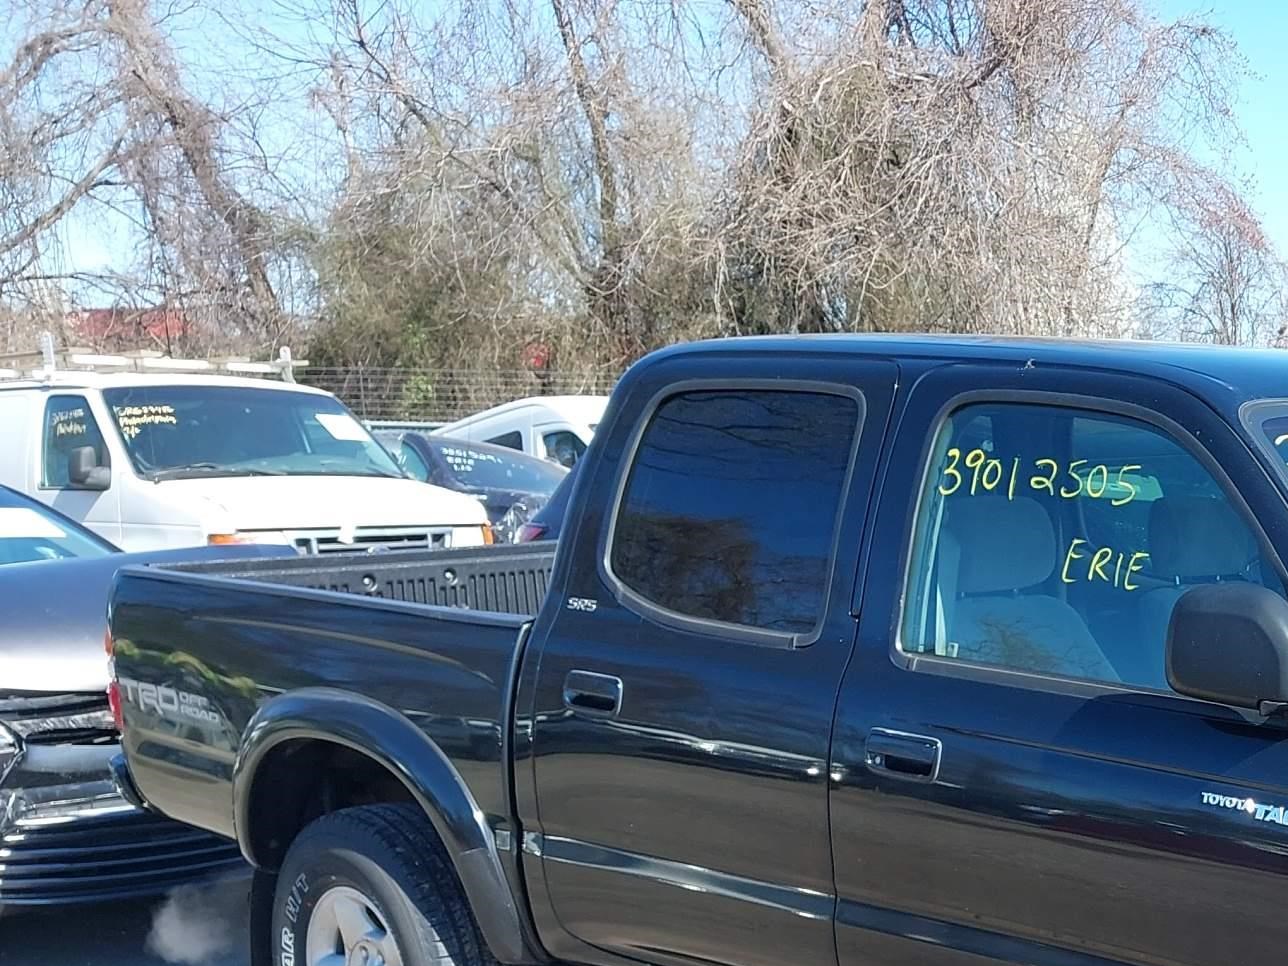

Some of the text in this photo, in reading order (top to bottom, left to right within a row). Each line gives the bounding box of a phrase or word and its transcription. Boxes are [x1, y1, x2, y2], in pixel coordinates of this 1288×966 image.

[938, 448, 1142, 506] 39012505
[1061, 537, 1150, 591] ERIE
[119, 677, 179, 716] TRD
[180, 703, 220, 722] ROAD
[1201, 791, 1255, 813] TOYOTA
